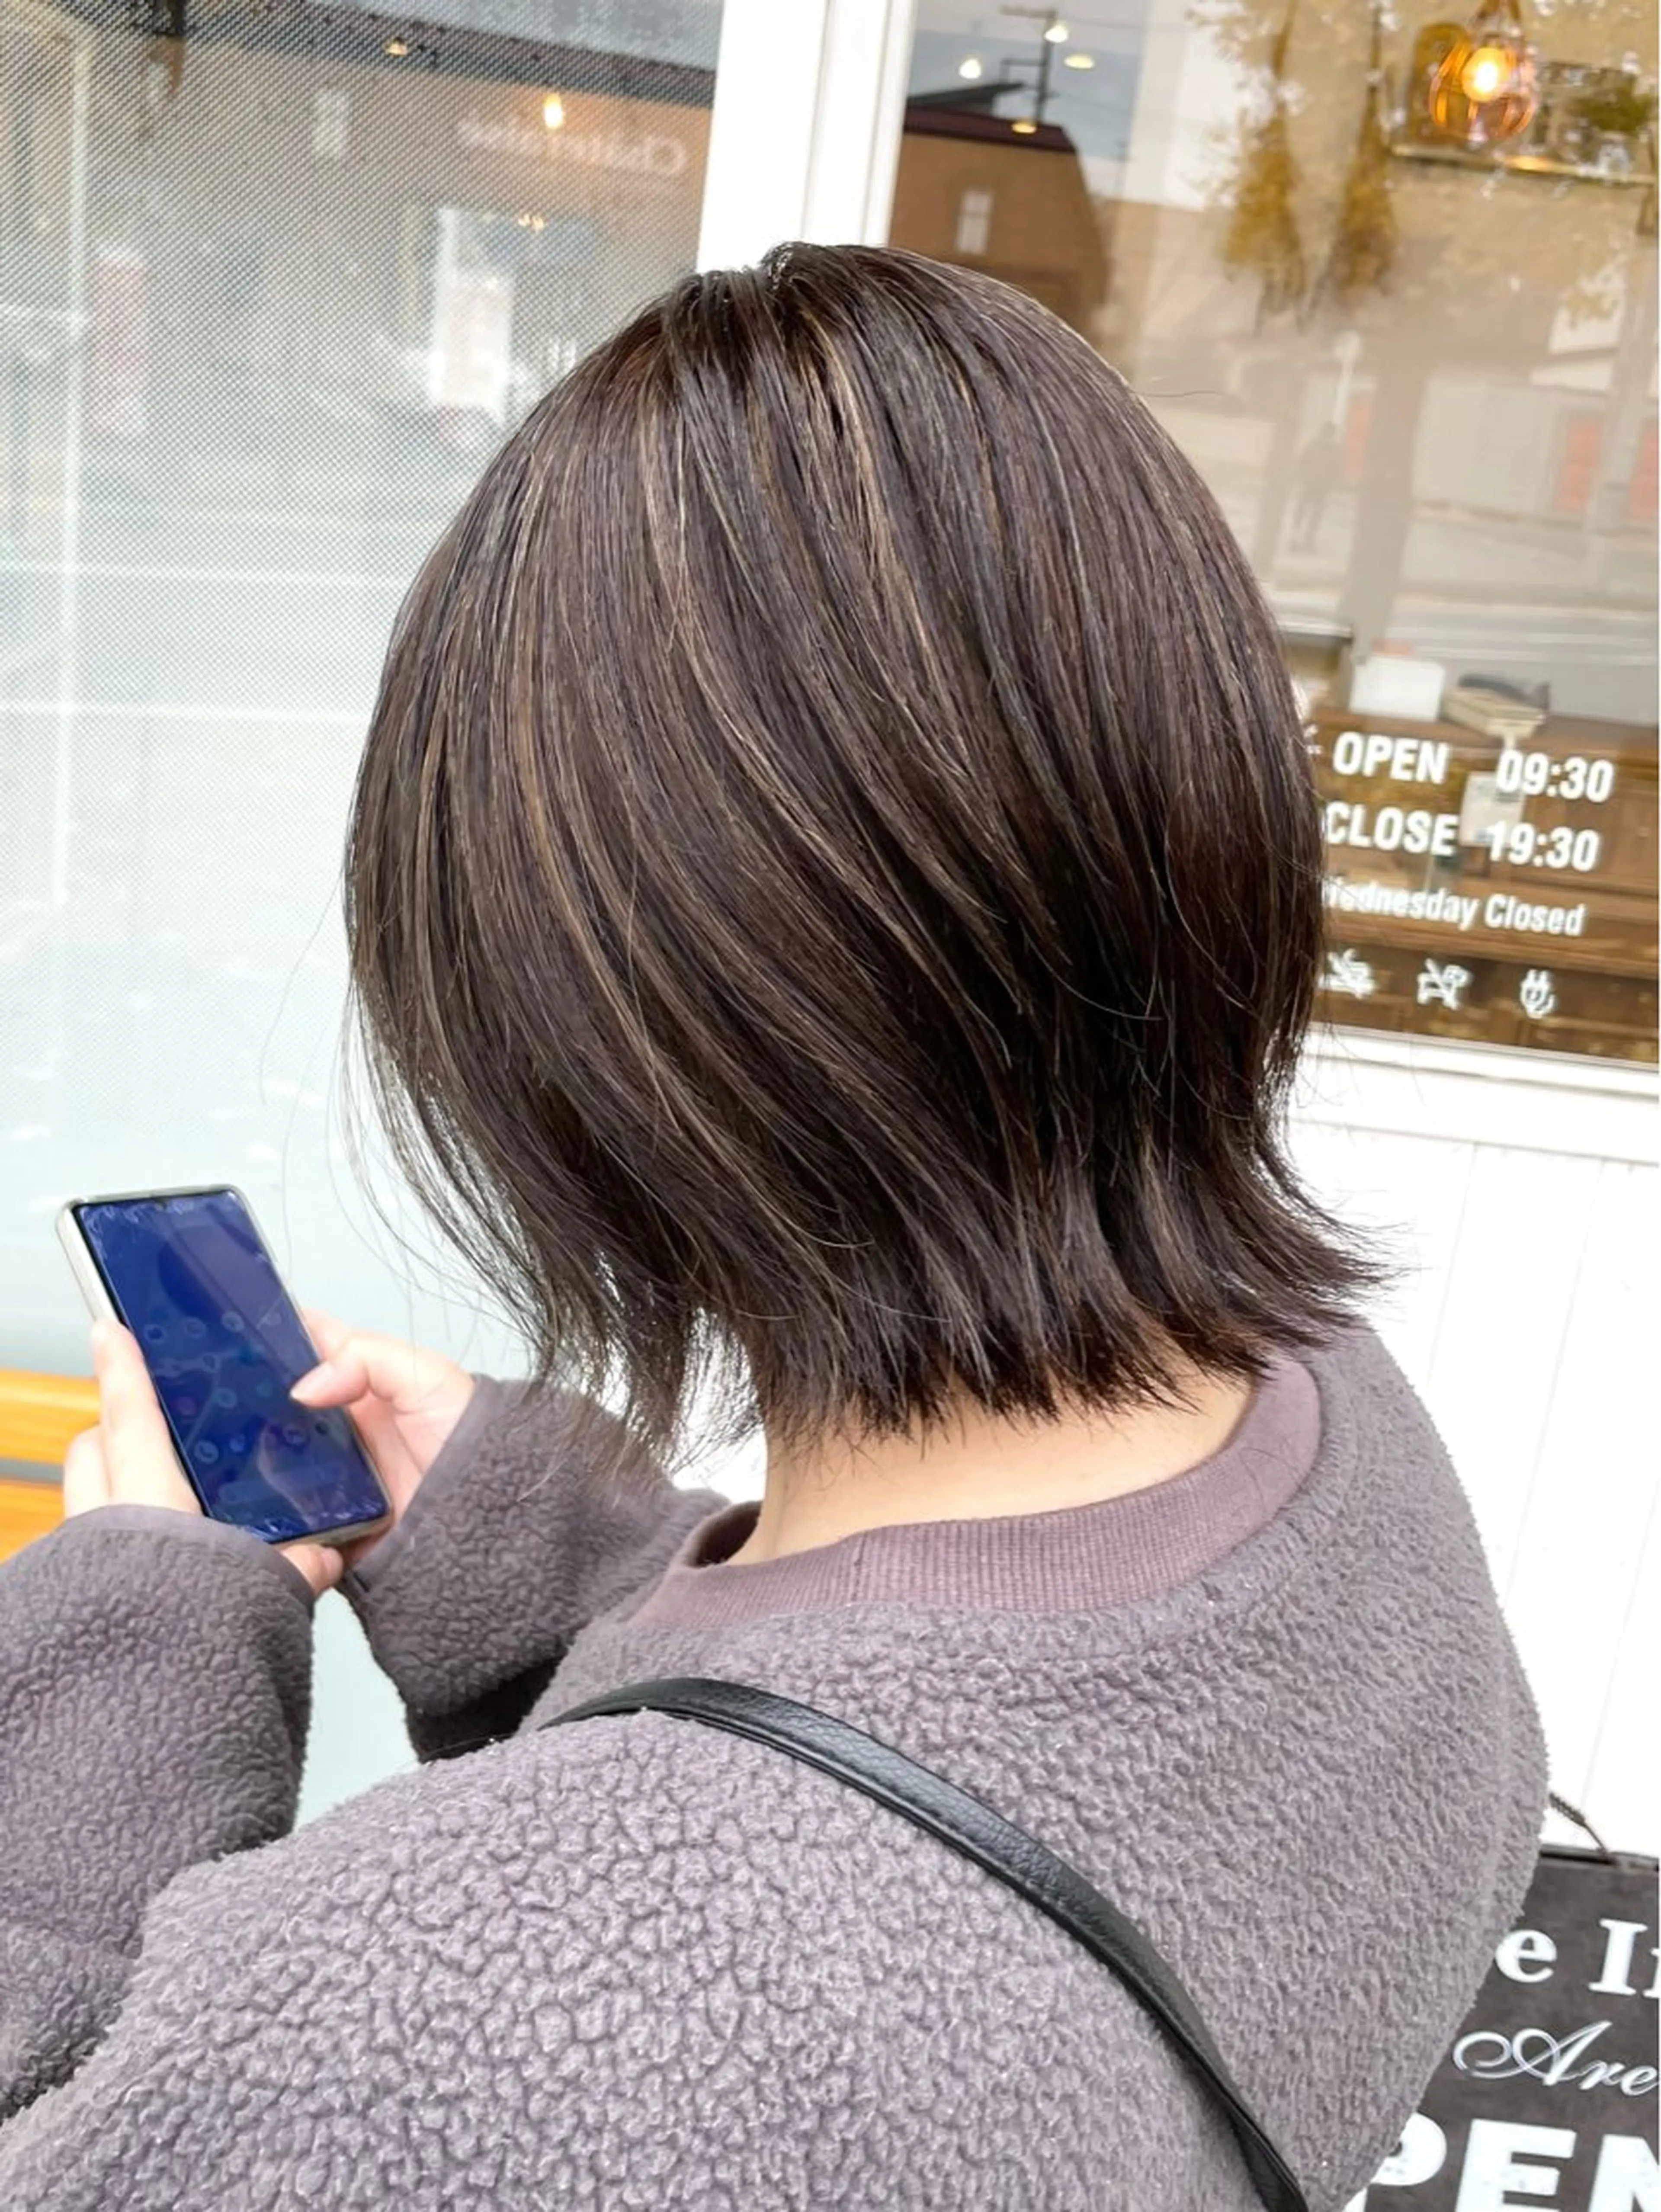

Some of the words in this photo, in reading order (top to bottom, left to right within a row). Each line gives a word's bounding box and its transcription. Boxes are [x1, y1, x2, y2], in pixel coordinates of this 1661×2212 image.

[1333, 731, 1450, 784] OPEN
[1497, 750, 1613, 802] 09:30
[1325, 801, 1459, 856] CLOSE
[1486, 821, 1599, 871] 19:30
[1485, 894, 1585, 936] Closed
[1453, 2020, 1660, 2096] Are
